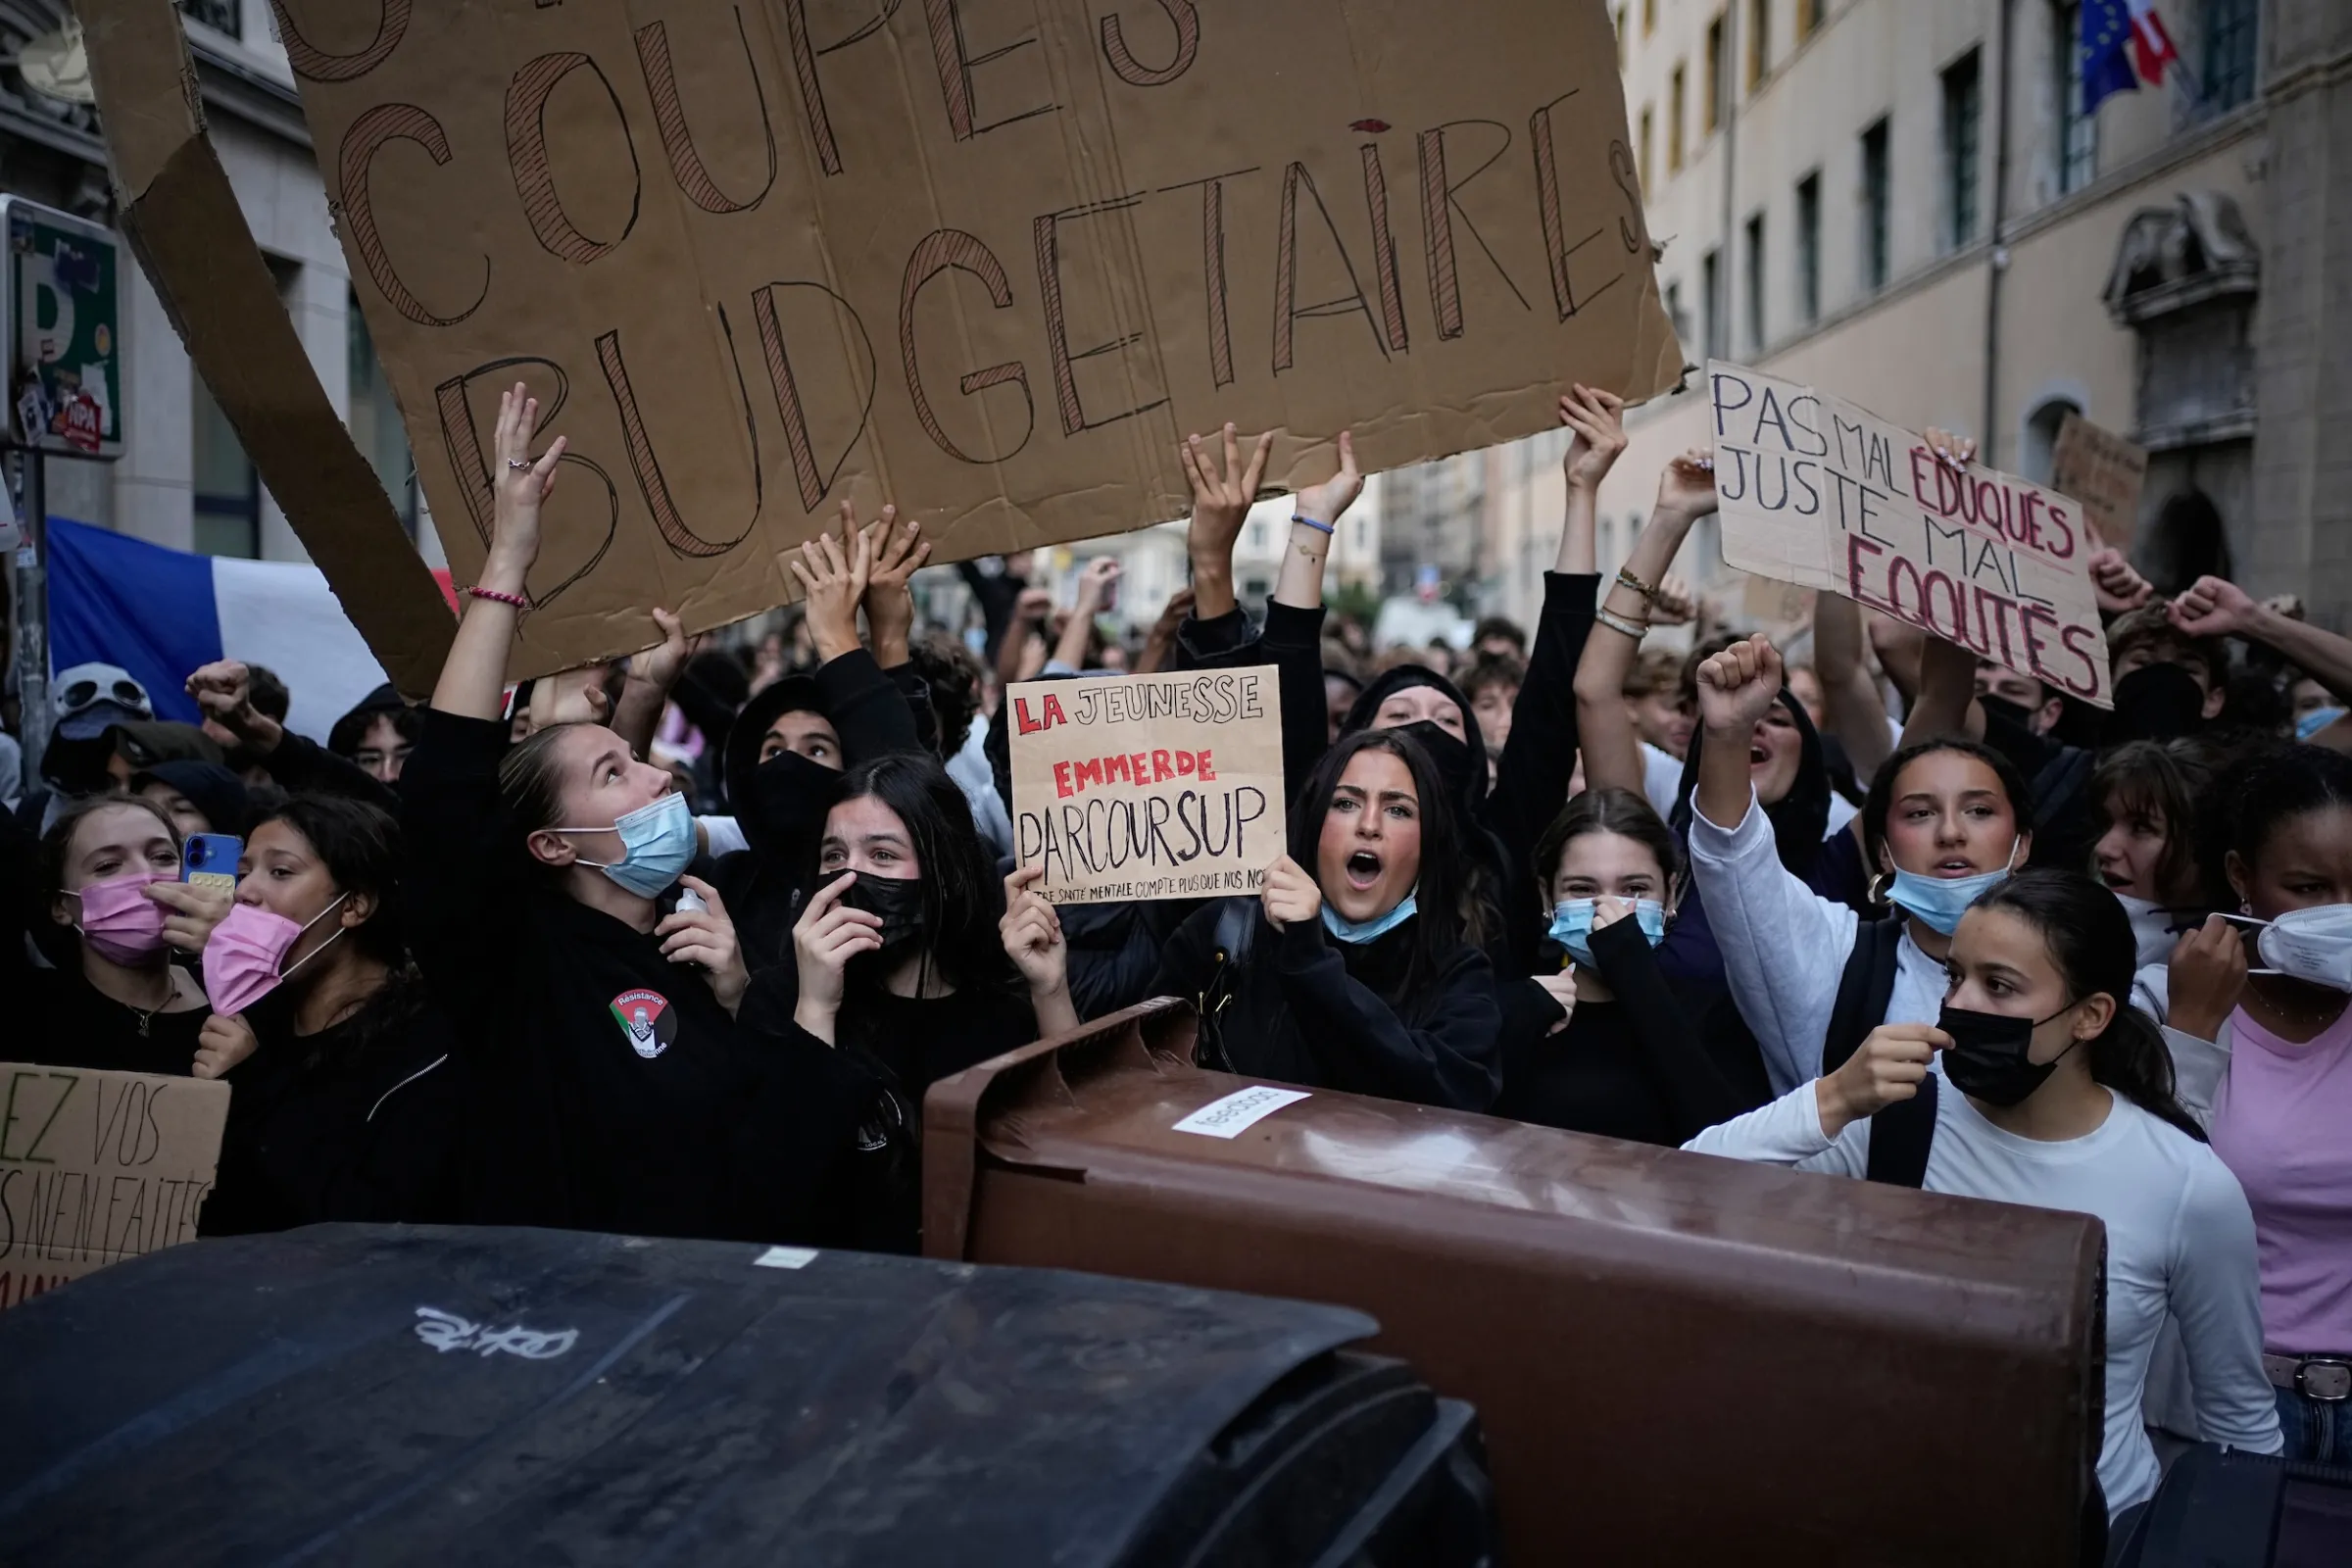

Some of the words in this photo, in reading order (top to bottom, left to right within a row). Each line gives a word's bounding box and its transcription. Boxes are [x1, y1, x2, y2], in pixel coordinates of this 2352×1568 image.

[1710, 374, 1829, 457] PAS
[1833, 414, 1909, 498] MAL
[1720, 444, 1895, 549] JUSTE
[1924, 514, 2054, 607] MAL
[1013, 693, 1068, 736] LA
[1074, 674, 1264, 726] JEUNESSE
[1053, 749, 1217, 799] EMMERDE
[1019, 786, 1267, 887] PARCOURSUP
[1058, 887, 1087, 903] SANTÉ
[1090, 882, 1134, 901] MENTALE
[1135, 877, 1177, 899] COMPTE
[1223, 870, 1243, 890] NOS
[617, 993, 664, 1006] Résistance
[94, 1078, 169, 1166] VOS
